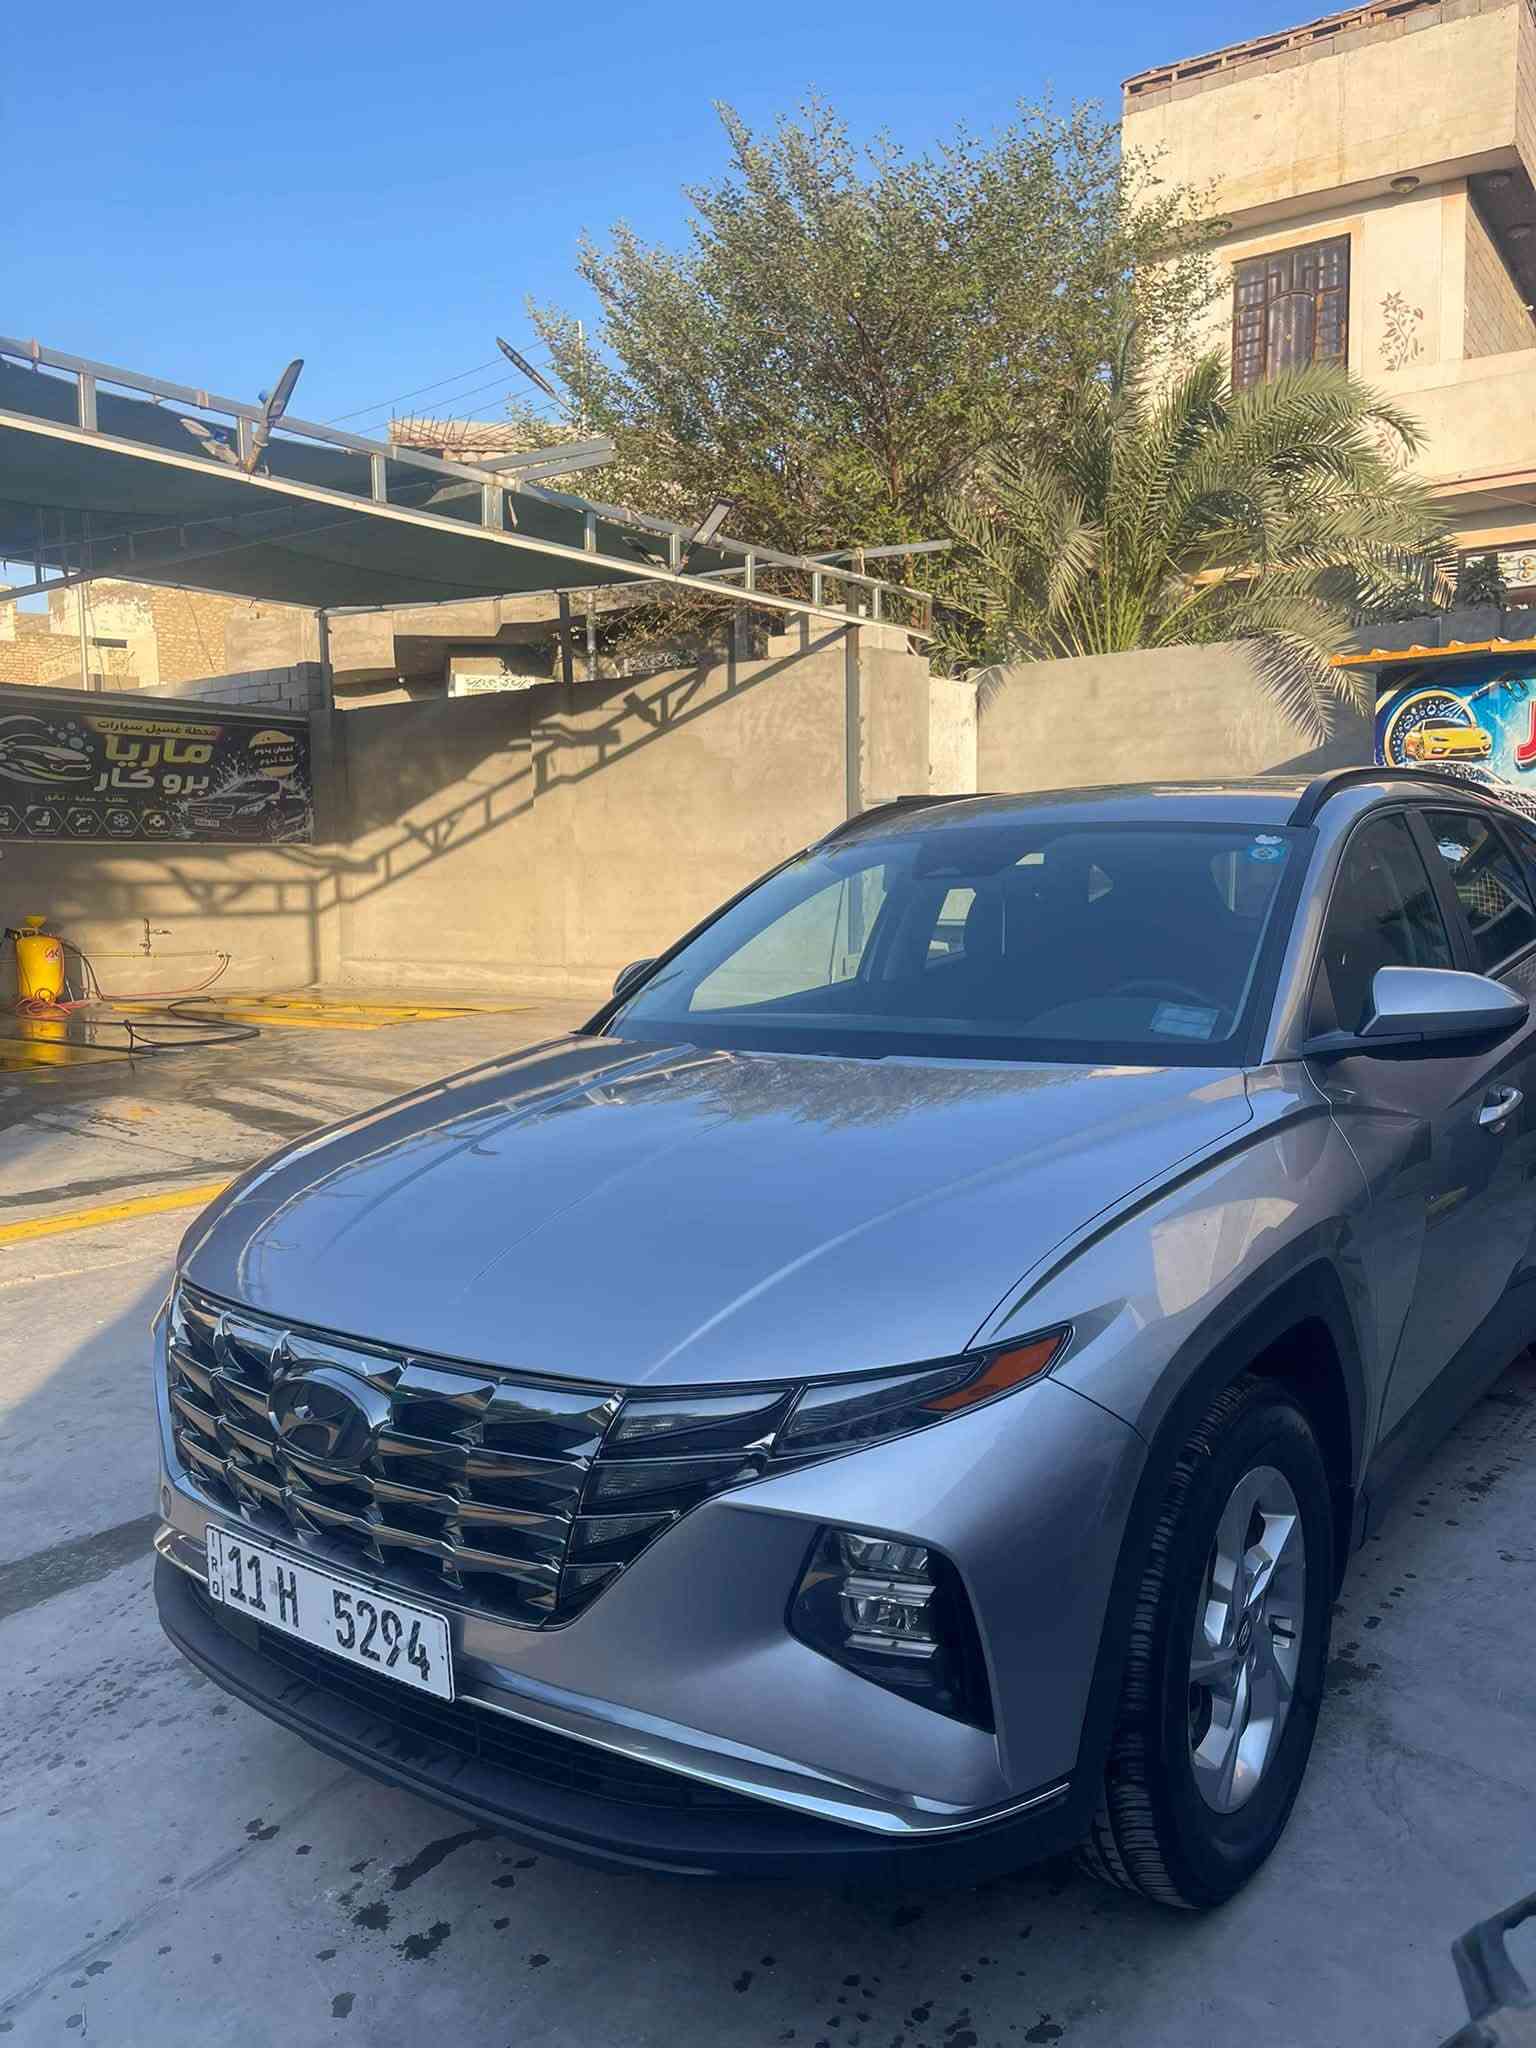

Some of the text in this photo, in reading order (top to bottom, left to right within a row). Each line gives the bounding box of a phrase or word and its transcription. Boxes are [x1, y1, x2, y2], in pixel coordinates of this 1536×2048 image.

[97, 719, 217, 737] محطة غسيل سيارات
[105, 734, 214, 769] ماريا
[93, 767, 209, 795] برو كار
[228, 1546, 430, 1681] 11 H 5294
